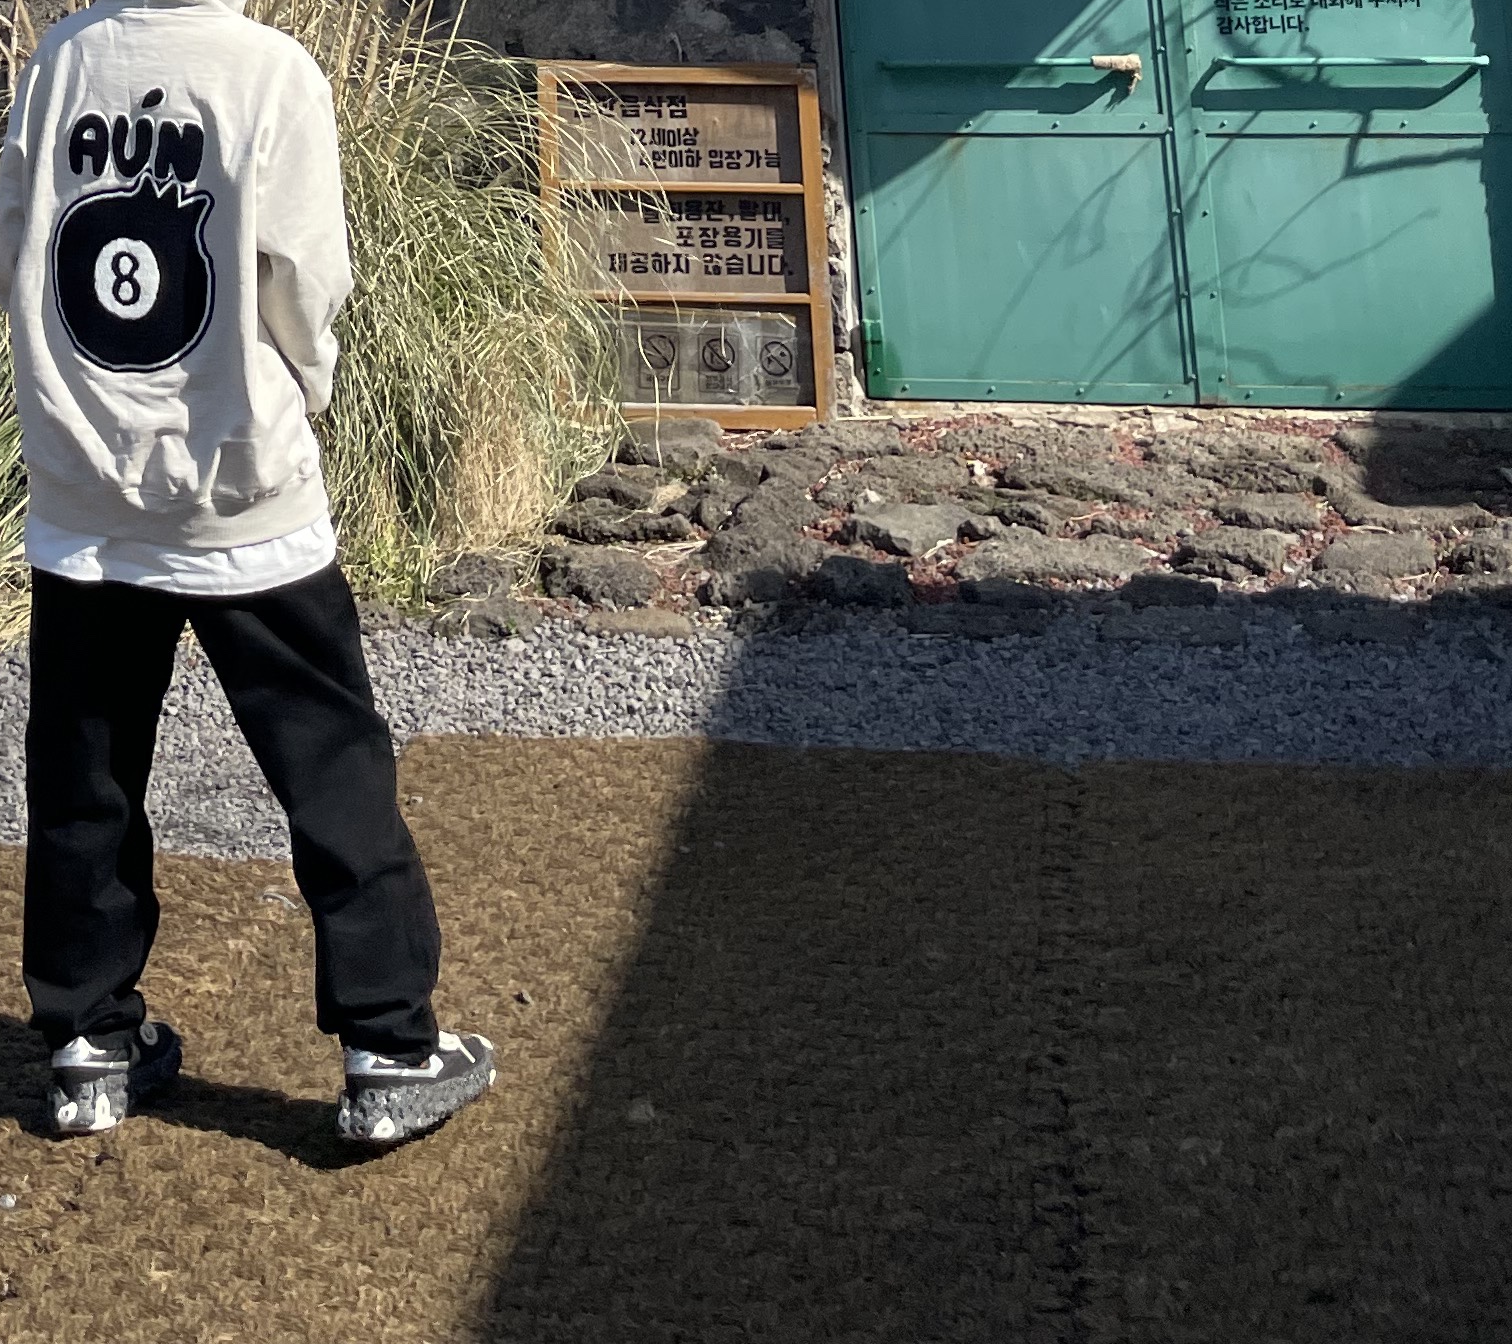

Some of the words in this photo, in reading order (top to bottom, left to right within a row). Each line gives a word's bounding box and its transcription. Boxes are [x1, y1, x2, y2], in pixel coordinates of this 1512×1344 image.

[1216, 14, 1310, 35] 감사합니다.
[708, 148, 782, 170] 입장가능
[676, 225, 786, 250] 포장용기를
[608, 251, 691, 274] 제공하지
[703, 252, 794, 276] 않습니다.
[112, 251, 140, 306] 8
